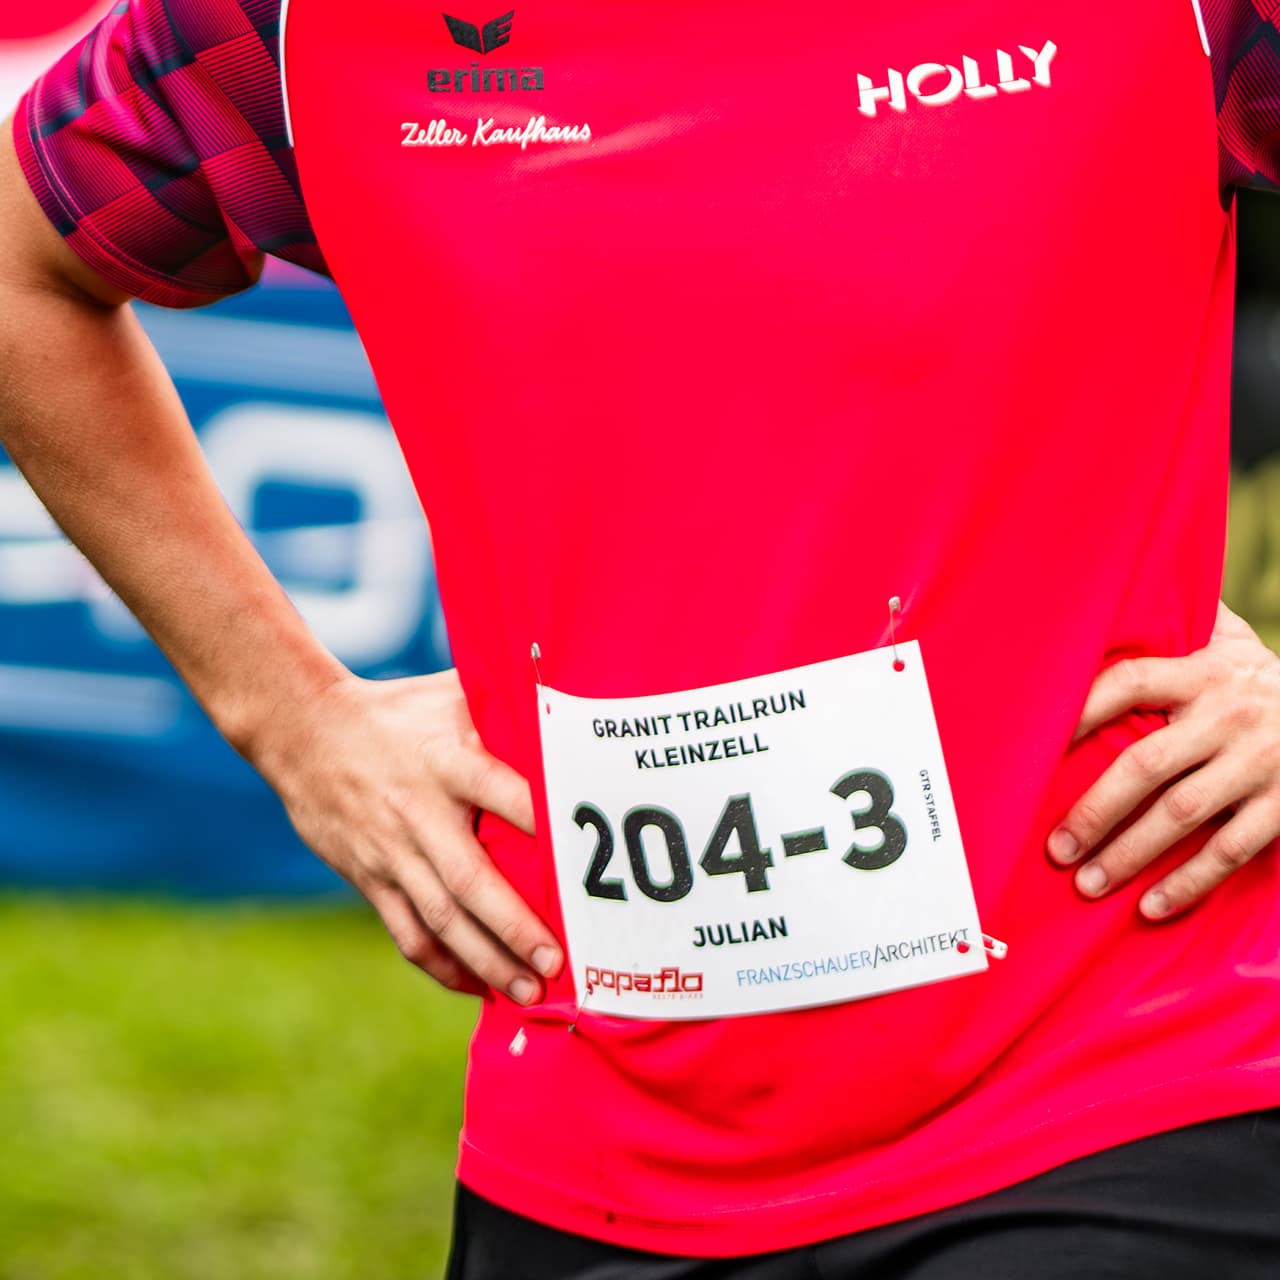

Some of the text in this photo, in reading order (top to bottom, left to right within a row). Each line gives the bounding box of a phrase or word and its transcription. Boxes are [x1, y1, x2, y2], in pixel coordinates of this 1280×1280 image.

[427, 61, 545, 93] erima
[856, 39, 1057, 118] HOLLY
[401, 115, 592, 150] Zeller Kaufhaus
[592, 688, 807, 738] GRANIT TRAILRUN
[634, 733, 769, 769] KLEINZELL
[919, 768, 942, 842] GTR STAFFEL
[572, 767, 908, 904] 204-3
[693, 916, 788, 948] JULIAN
